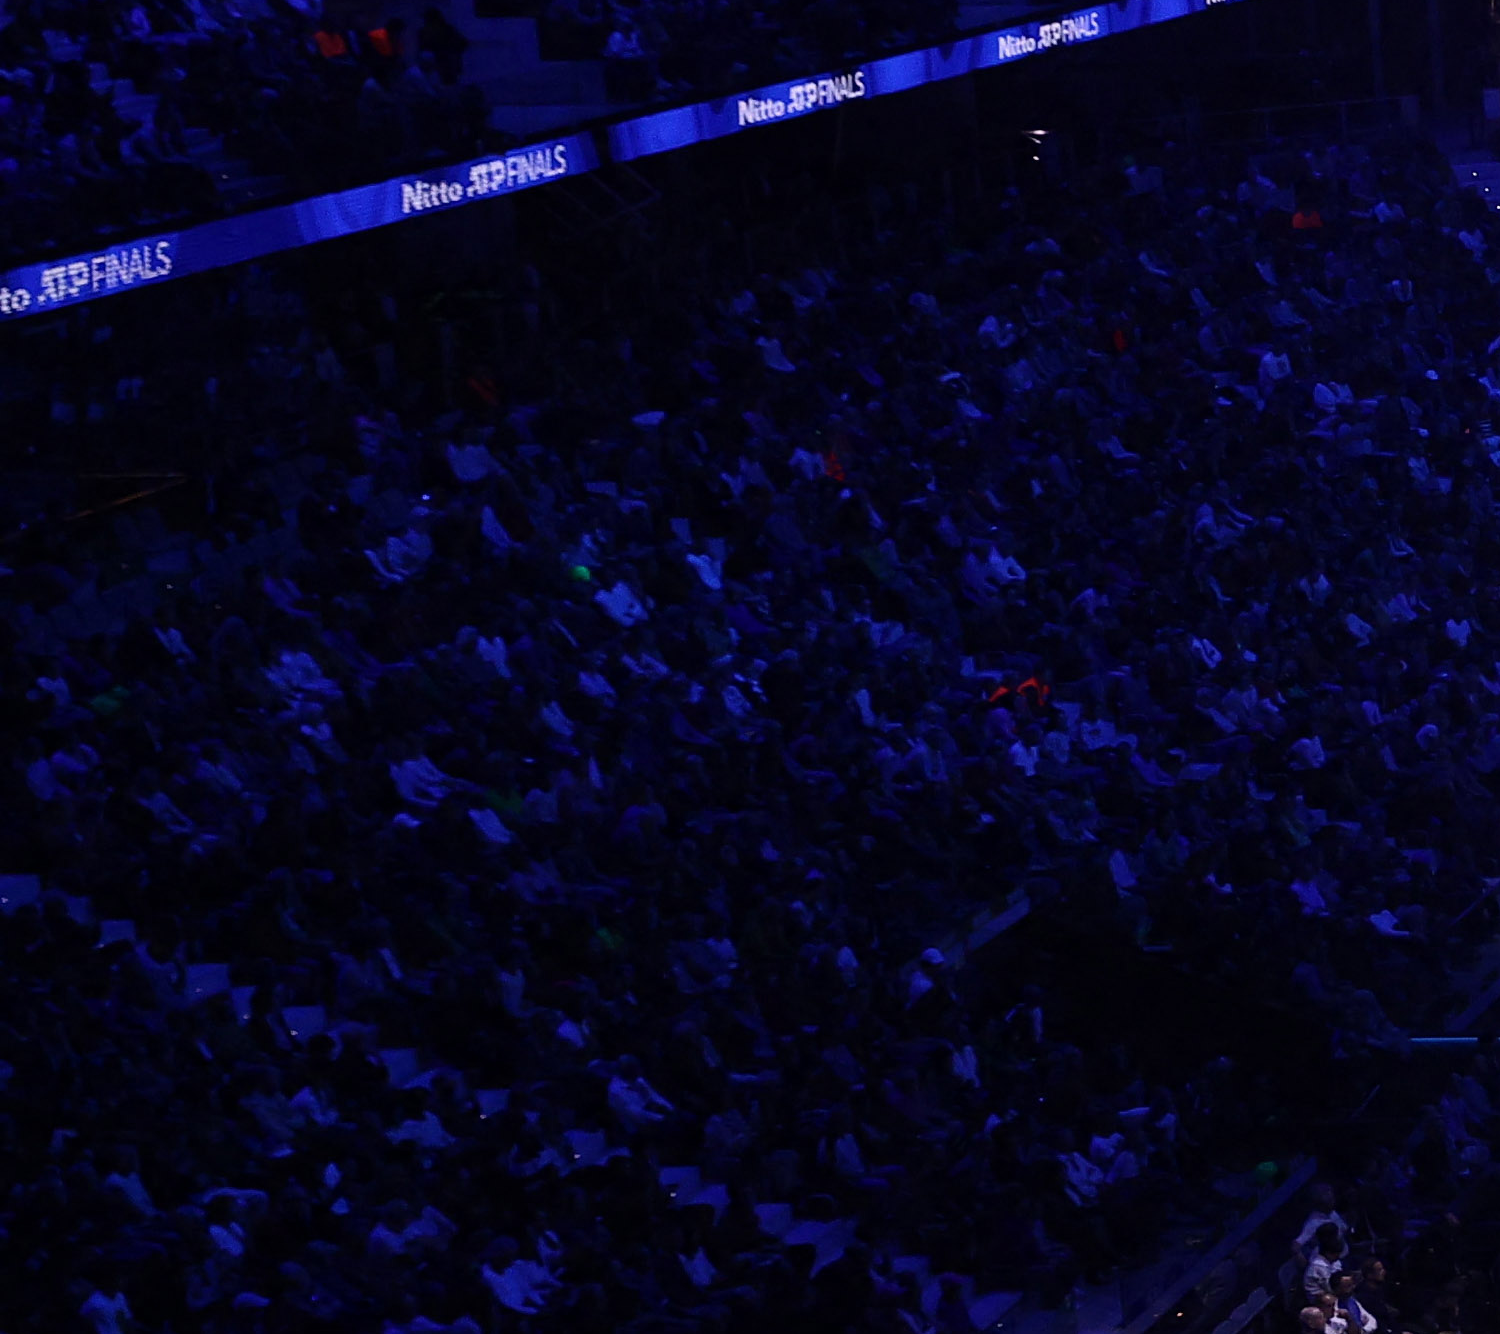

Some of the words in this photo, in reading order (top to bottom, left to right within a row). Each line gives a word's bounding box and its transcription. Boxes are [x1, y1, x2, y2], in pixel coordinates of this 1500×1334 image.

[998, 31, 1036, 60] Nitto
[1061, 12, 1099, 43] FINALS
[738, 93, 786, 126] Nitto
[786, 83, 819, 114] ATP
[817, 71, 866, 106] FINALS
[402, 177, 465, 215] Nitto
[465, 161, 509, 199] ATP
[504, 144, 568, 188] FINALS
[36, 260, 90, 305] ATP
[89, 240, 173, 296] FINALS
